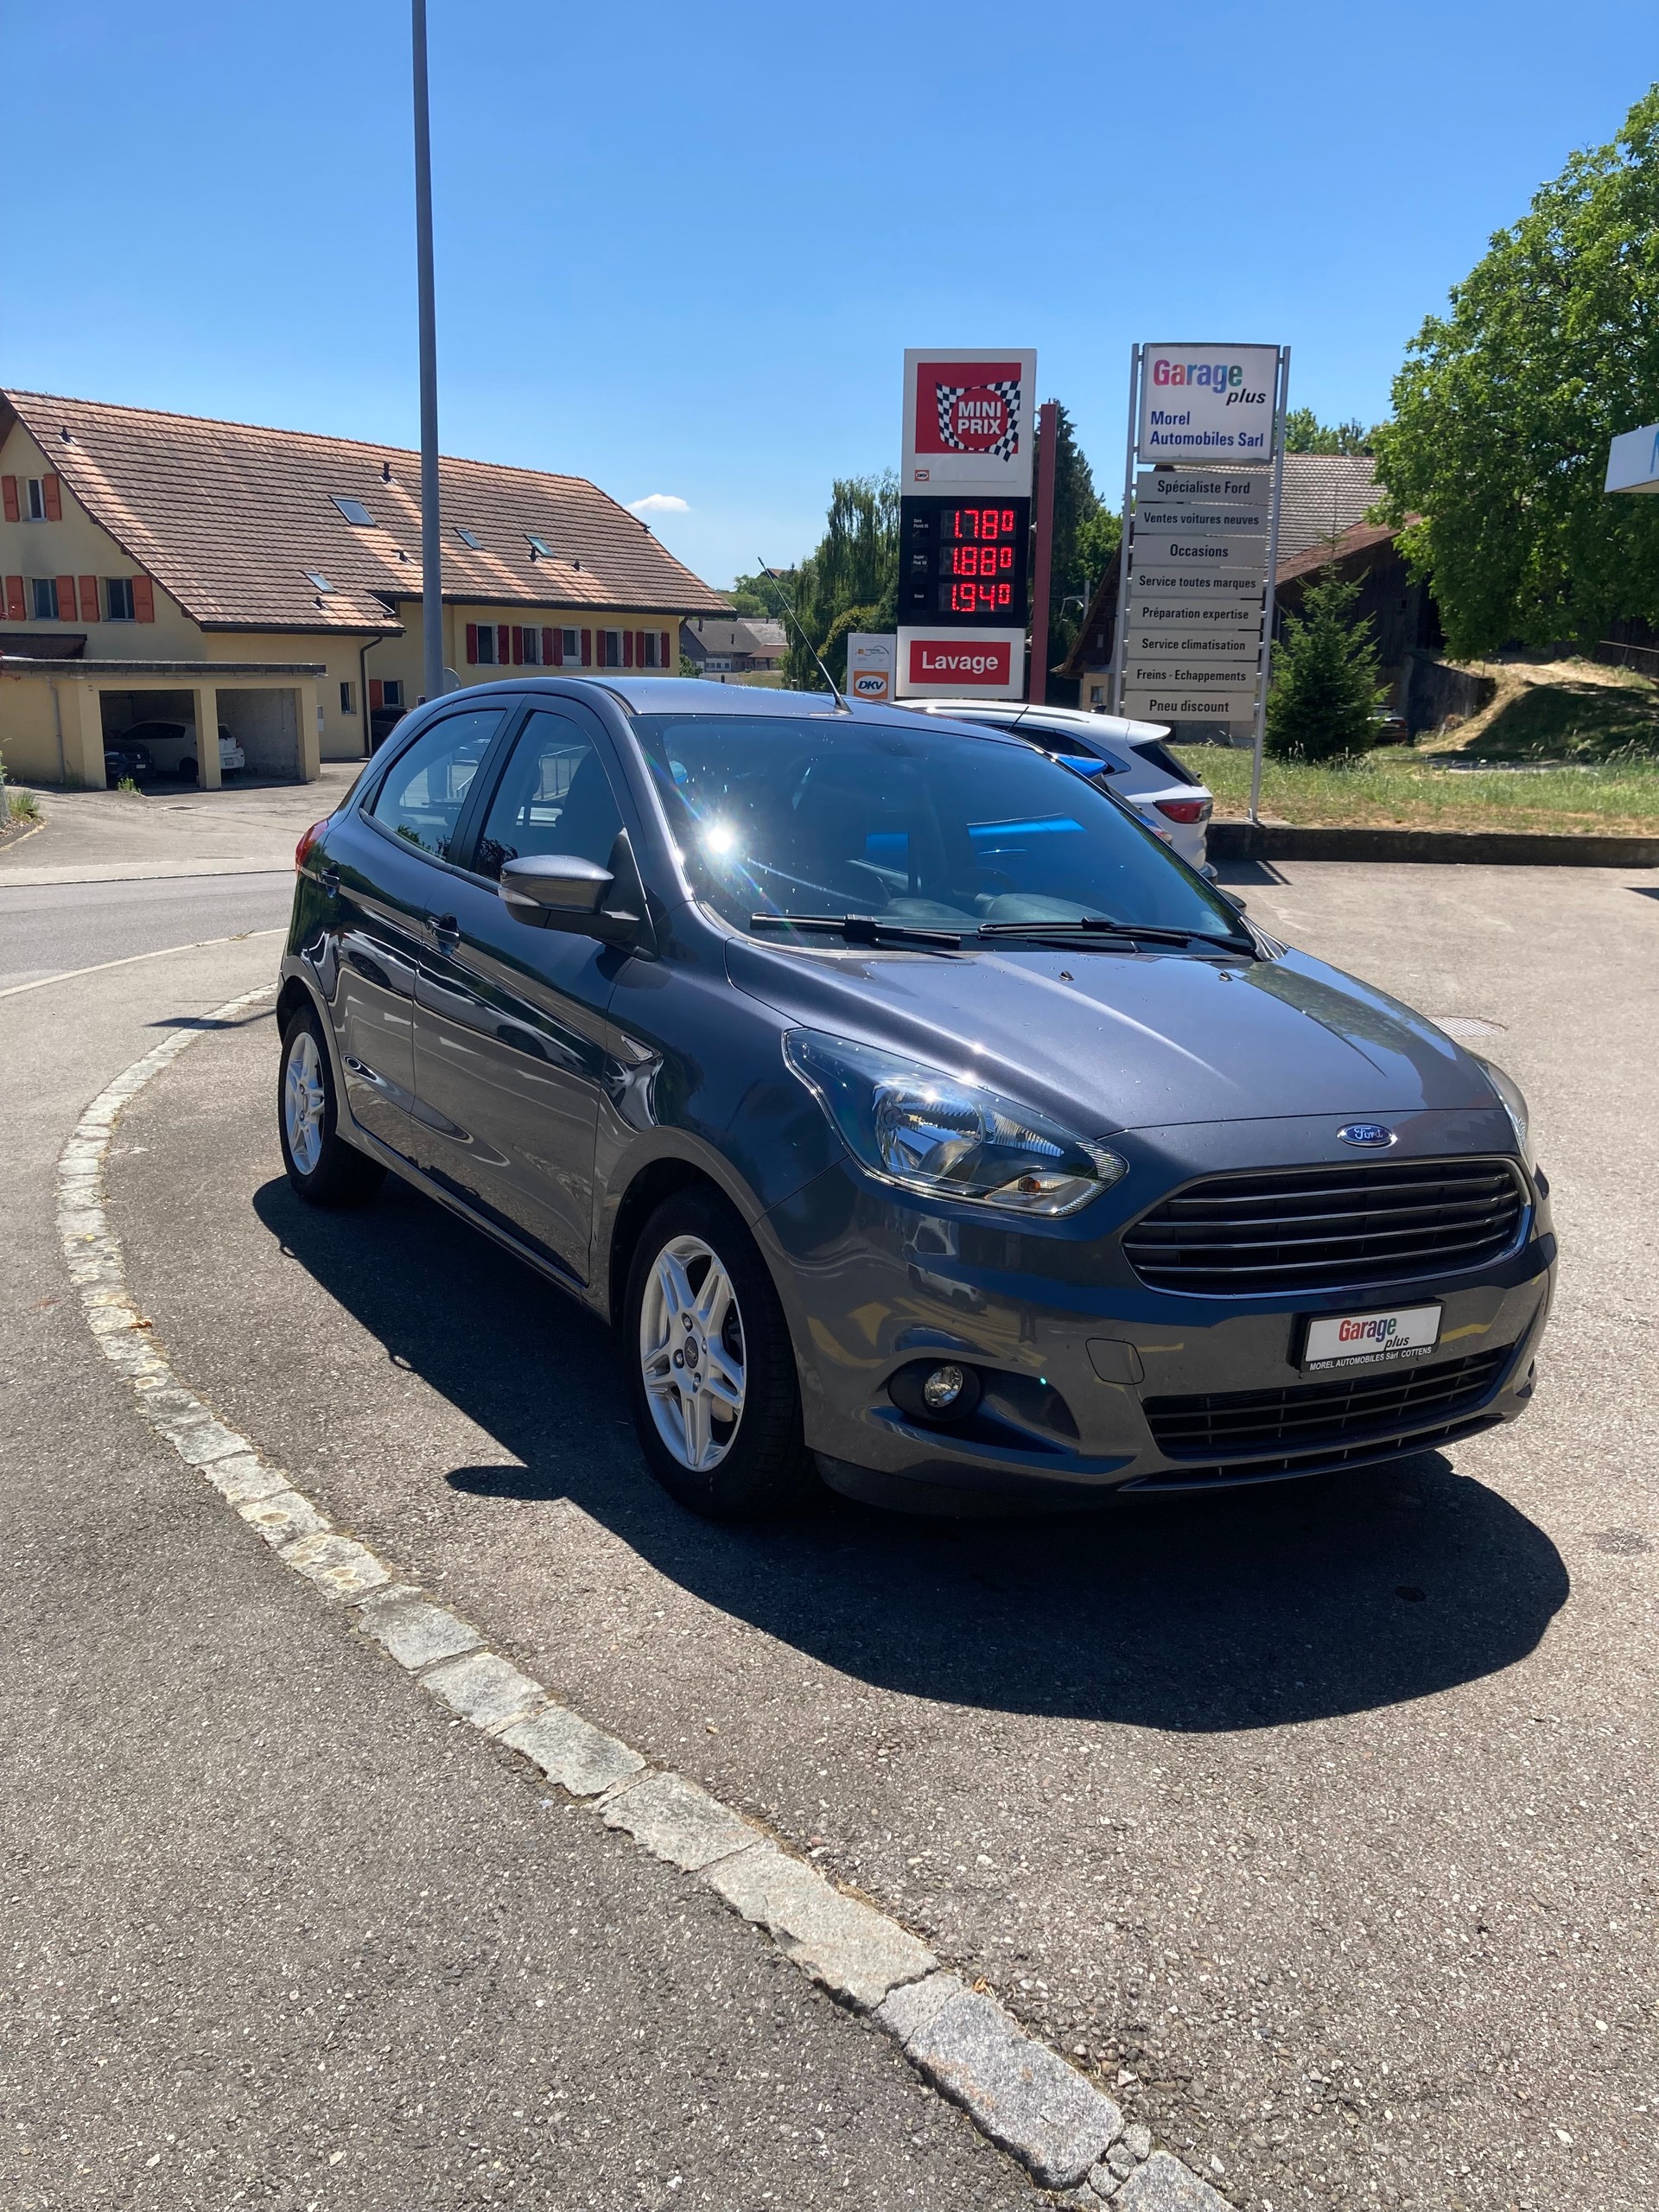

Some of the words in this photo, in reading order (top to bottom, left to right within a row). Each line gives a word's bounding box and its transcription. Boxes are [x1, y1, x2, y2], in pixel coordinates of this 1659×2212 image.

[1154, 359, 1243, 394] Garage
[1225, 388, 1267, 406] plus
[958, 401, 1001, 417] MINI
[1150, 410, 1191, 426] Morel
[957, 419, 1001, 435] PRIX
[1149, 430, 1234, 447] Automobiles
[1238, 432, 1264, 448] Sarl
[1157, 480, 1221, 495] Spécialiste
[1224, 481, 1250, 494] Ford
[1143, 512, 1178, 524] Ventes
[1180, 512, 1221, 524] voitures
[1224, 515, 1259, 525] neuves
[1170, 543, 1229, 557] Occasions
[1139, 575, 1176, 587] Service
[1179, 577, 1211, 588] toutes
[1213, 578, 1256, 590] marques
[1142, 607, 1200, 620] Préparation
[1203, 608, 1249, 621] expertise
[1141, 638, 1179, 650] Service
[1181, 639, 1246, 651] climatisation
[922, 652, 999, 674] Lavage
[1136, 669, 1166, 680] Freins
[1175, 670, 1246, 683] Echappements
[858, 681, 885, 690] DKV
[1149, 699, 1178, 712] Pneu
[1180, 700, 1230, 713] discount
[1354, 1127, 1383, 1140] Ford
[1339, 1318, 1397, 1343] Garage
[1384, 1336, 1410, 1351] plus
[1309, 1360, 1334, 1371] MOREL
[1336, 1353, 1384, 1367] AUTOMOBILES
[1401, 1346, 1432, 1358] COTTENS
